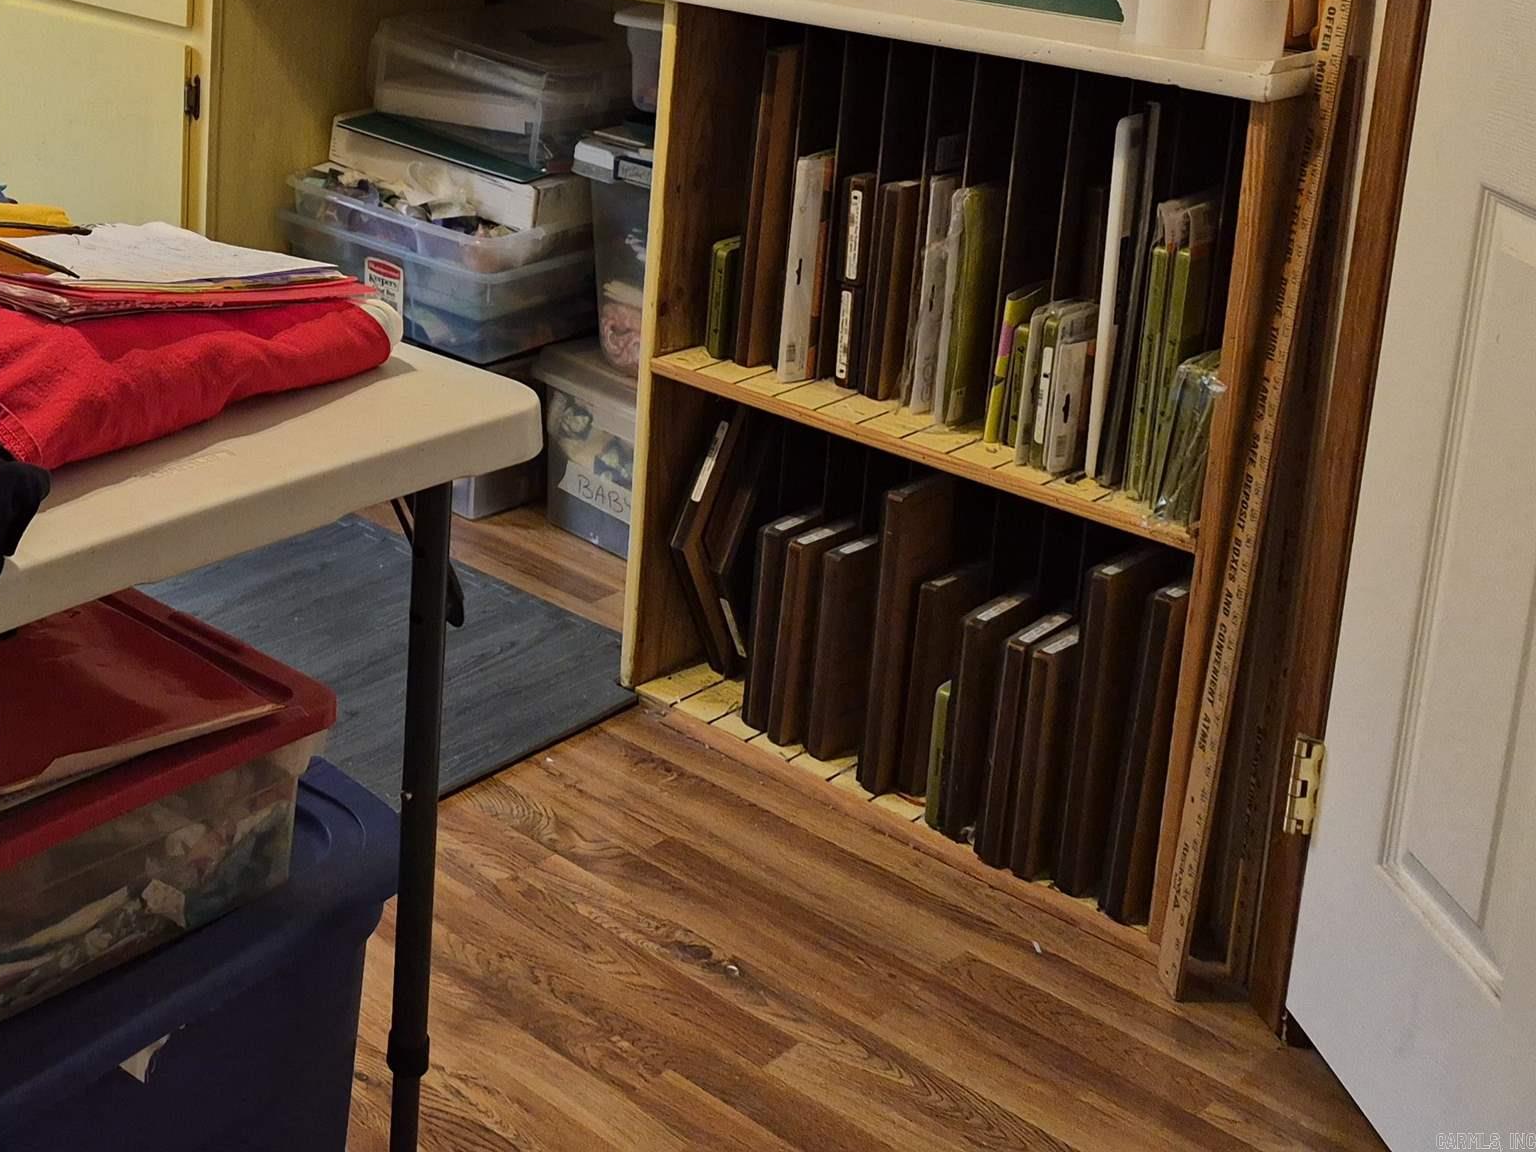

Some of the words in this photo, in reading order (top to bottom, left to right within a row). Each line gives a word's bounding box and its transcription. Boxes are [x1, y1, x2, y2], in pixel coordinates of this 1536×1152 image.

[1320, 5, 1337, 52] OFFER
[1247, 432, 1262, 467] SAFE
[1236, 472, 1255, 532] DEPOSIT
[1227, 536, 1244, 582] BOXES
[1220, 587, 1235, 617] AND
[1205, 622, 1229, 706] CONVENIENT
